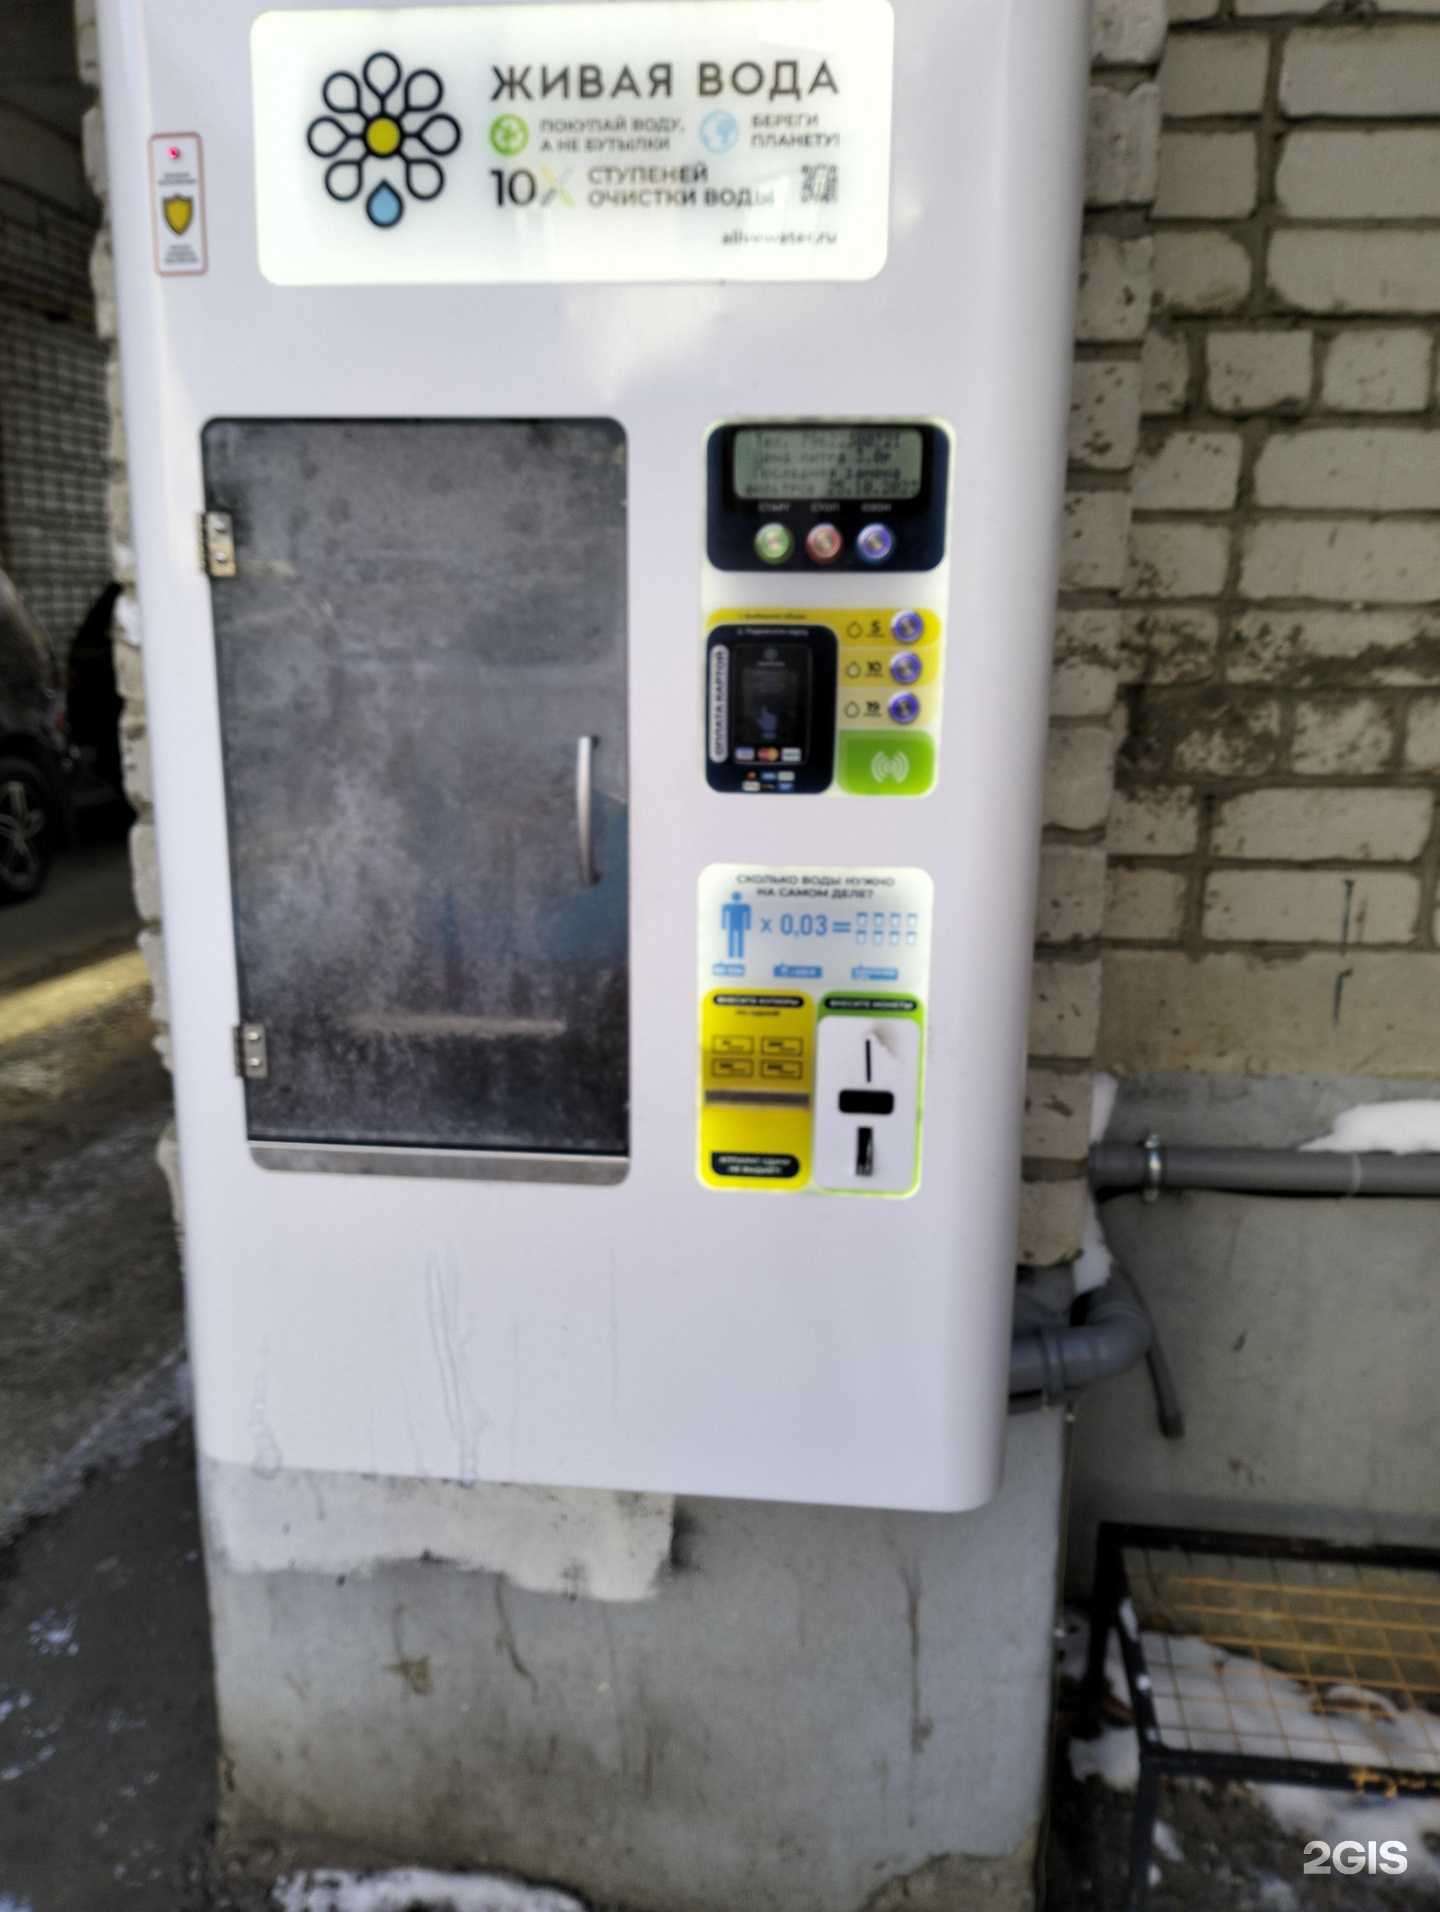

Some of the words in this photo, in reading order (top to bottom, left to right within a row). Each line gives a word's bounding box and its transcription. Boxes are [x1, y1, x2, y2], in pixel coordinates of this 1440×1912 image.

[490, 63, 673, 101] ЖИВАЯ
[697, 60, 839, 101] ВОДА
[540, 115, 627, 133] ПОКУПАЙ
[752, 113, 819, 128] БЕРЕГИ
[541, 139, 553, 151] А
[557, 138, 579, 150] НЕ
[584, 137, 671, 151] БУТЫЛКИ
[587, 161, 709, 185] СТУПЕНЕЙ
[587, 187, 698, 208] ОЧИСТКИ
[705, 186, 775, 209] ВОДЫ
[736, 874, 798, 886] СКОЛЬКО
[801, 875, 841, 887] ВОДЫ
[757, 887, 775, 897] НА
[778, 887, 829, 899] САМОМ
[780, 913, 828, 938] 0,03
